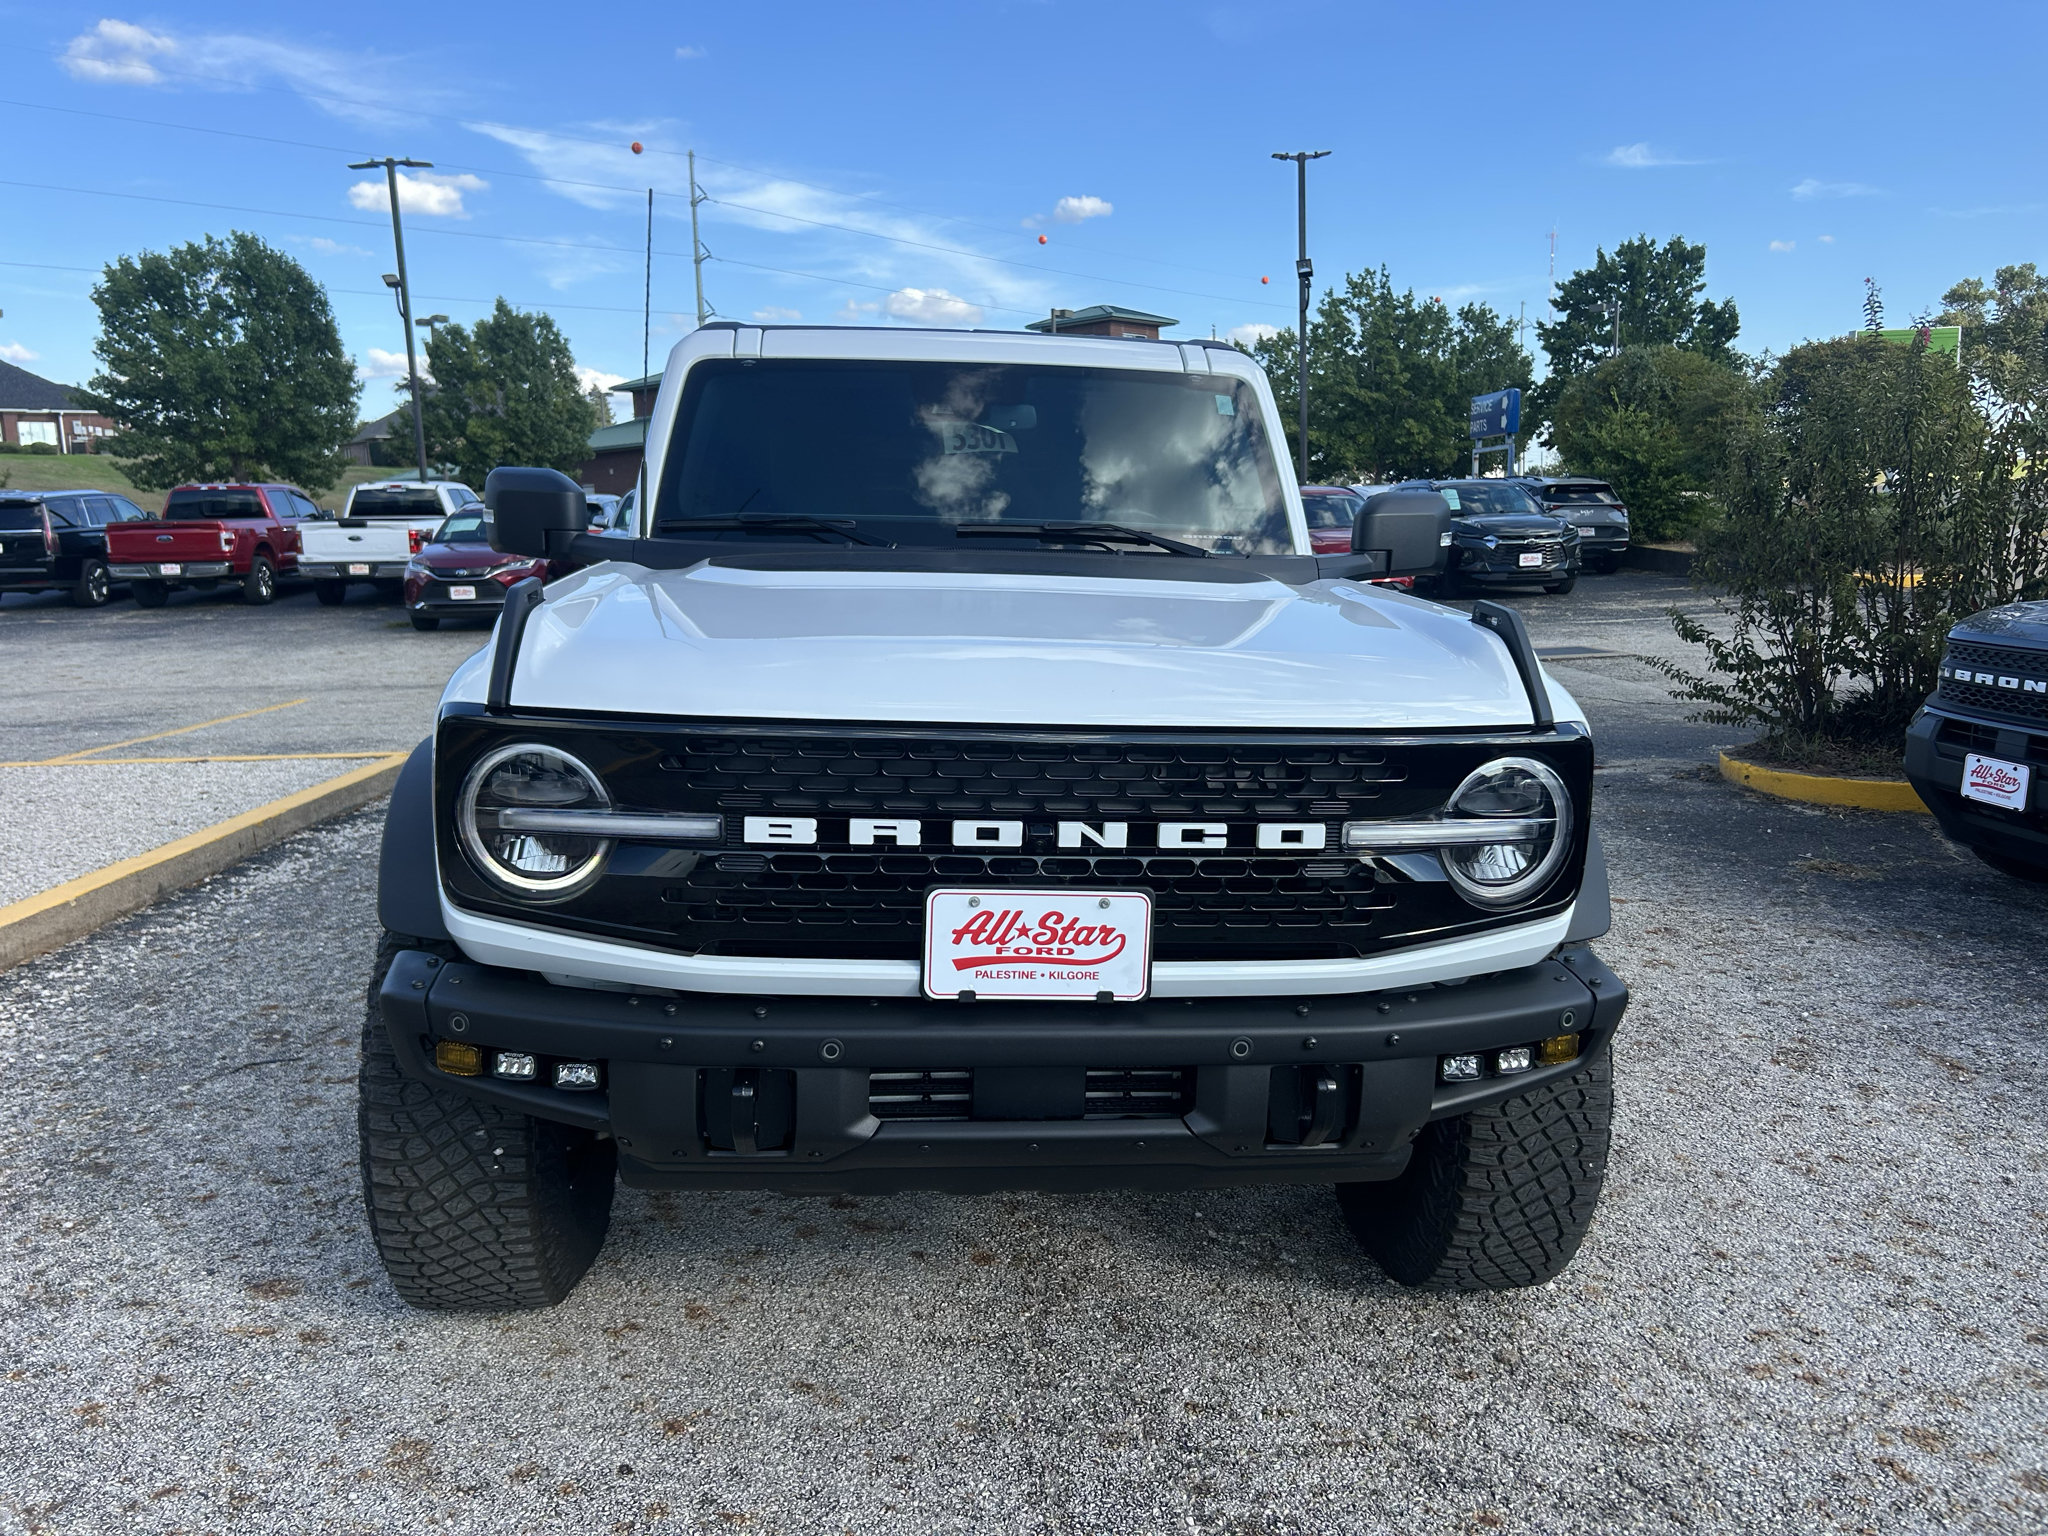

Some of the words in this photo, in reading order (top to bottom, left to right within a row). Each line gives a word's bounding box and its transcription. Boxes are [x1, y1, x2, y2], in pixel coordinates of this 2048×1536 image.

[1470, 418, 1487, 433] PARTS
[743, 815, 1326, 850] BRONCO
[951, 909, 1024, 946] All
[1031, 910, 1123, 947] Star
[995, 946, 1075, 956] FORD
[975, 970, 1037, 980] PALESTINE
[1048, 971, 1100, 981] KILGORE
